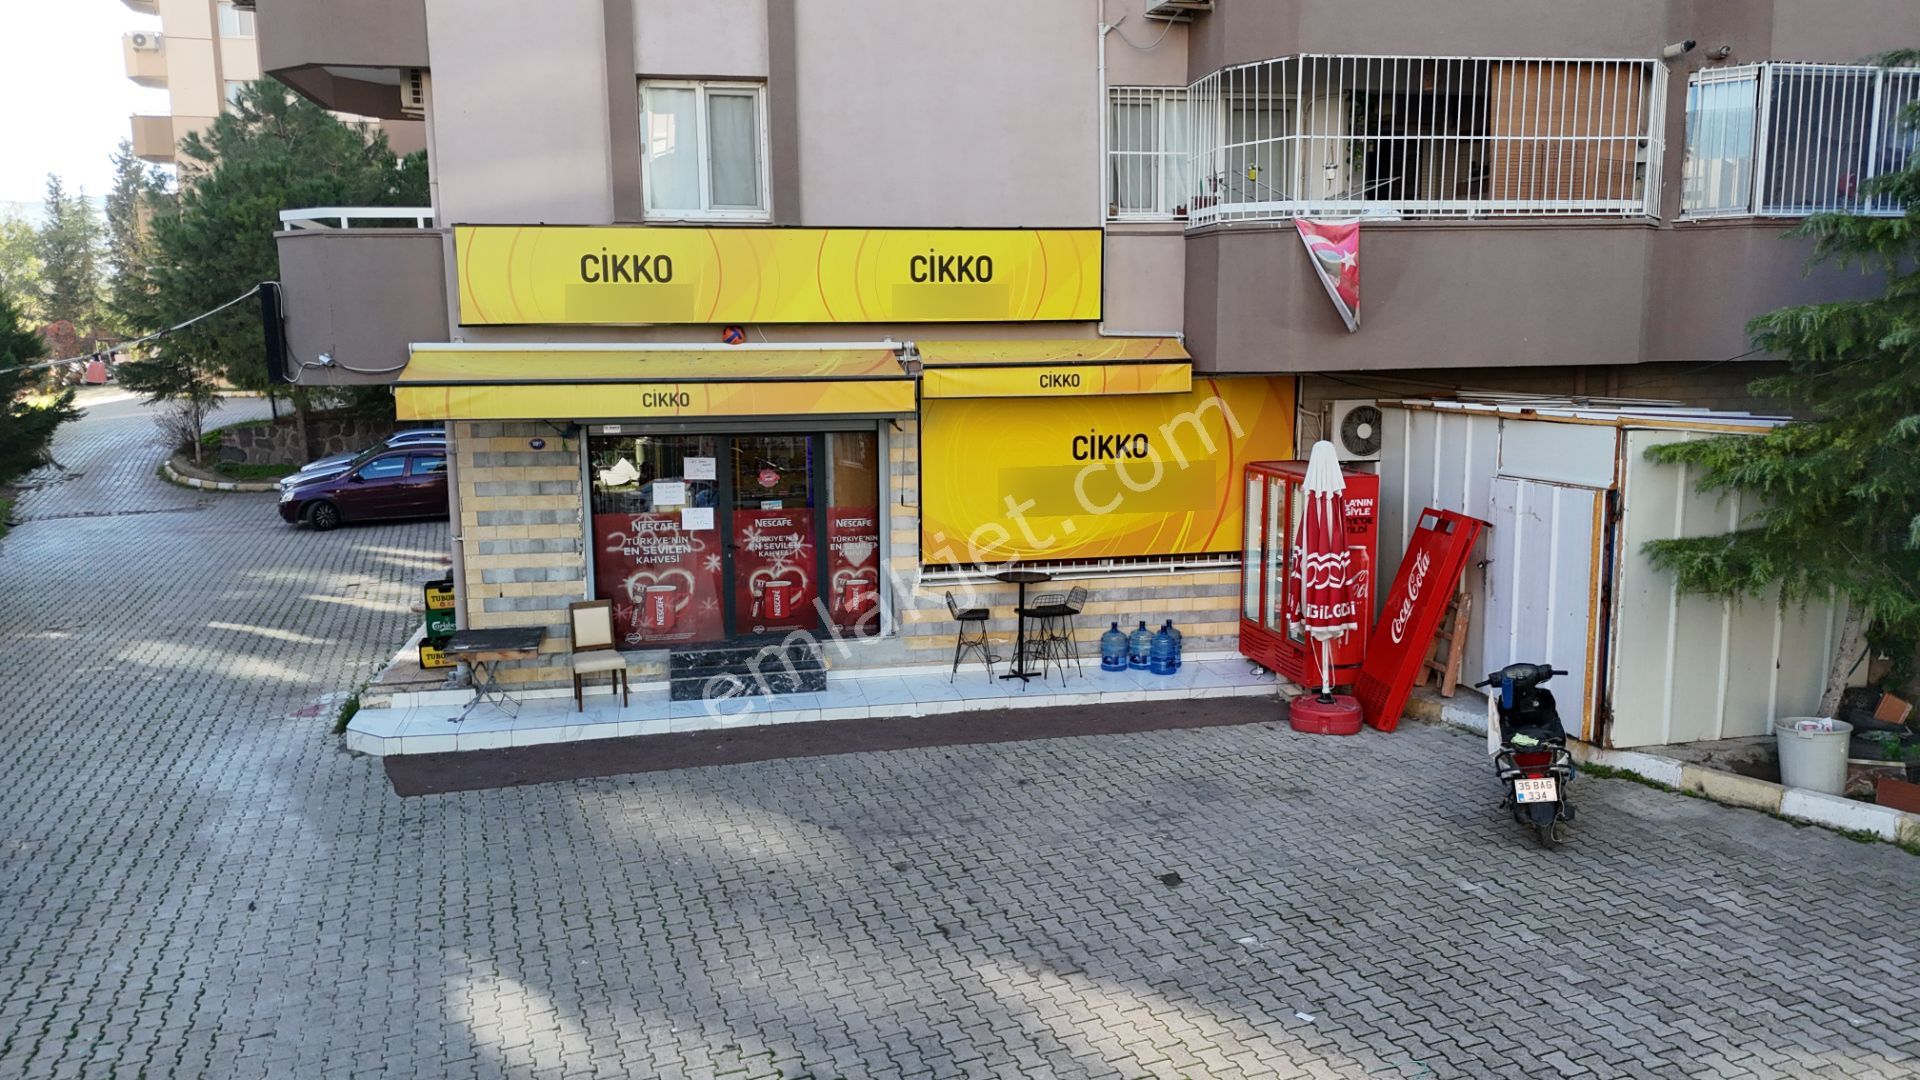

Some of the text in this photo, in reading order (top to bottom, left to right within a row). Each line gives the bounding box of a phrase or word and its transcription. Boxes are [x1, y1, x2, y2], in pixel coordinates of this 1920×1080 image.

[580, 247, 673, 284] CİKKO
[910, 248, 994, 283] CİKKO
[1039, 370, 1081, 389] CİKKO
[642, 387, 690, 408] CİKKO
[1072, 428, 1149, 462] CİKKO
[623, 544, 691, 556] EN SEVİLEN
[830, 543, 842, 551] EN
[636, 554, 680, 565] KAHVESİ
[1518, 780, 1552, 791] 35 BAG
[1528, 791, 1547, 800] 334
